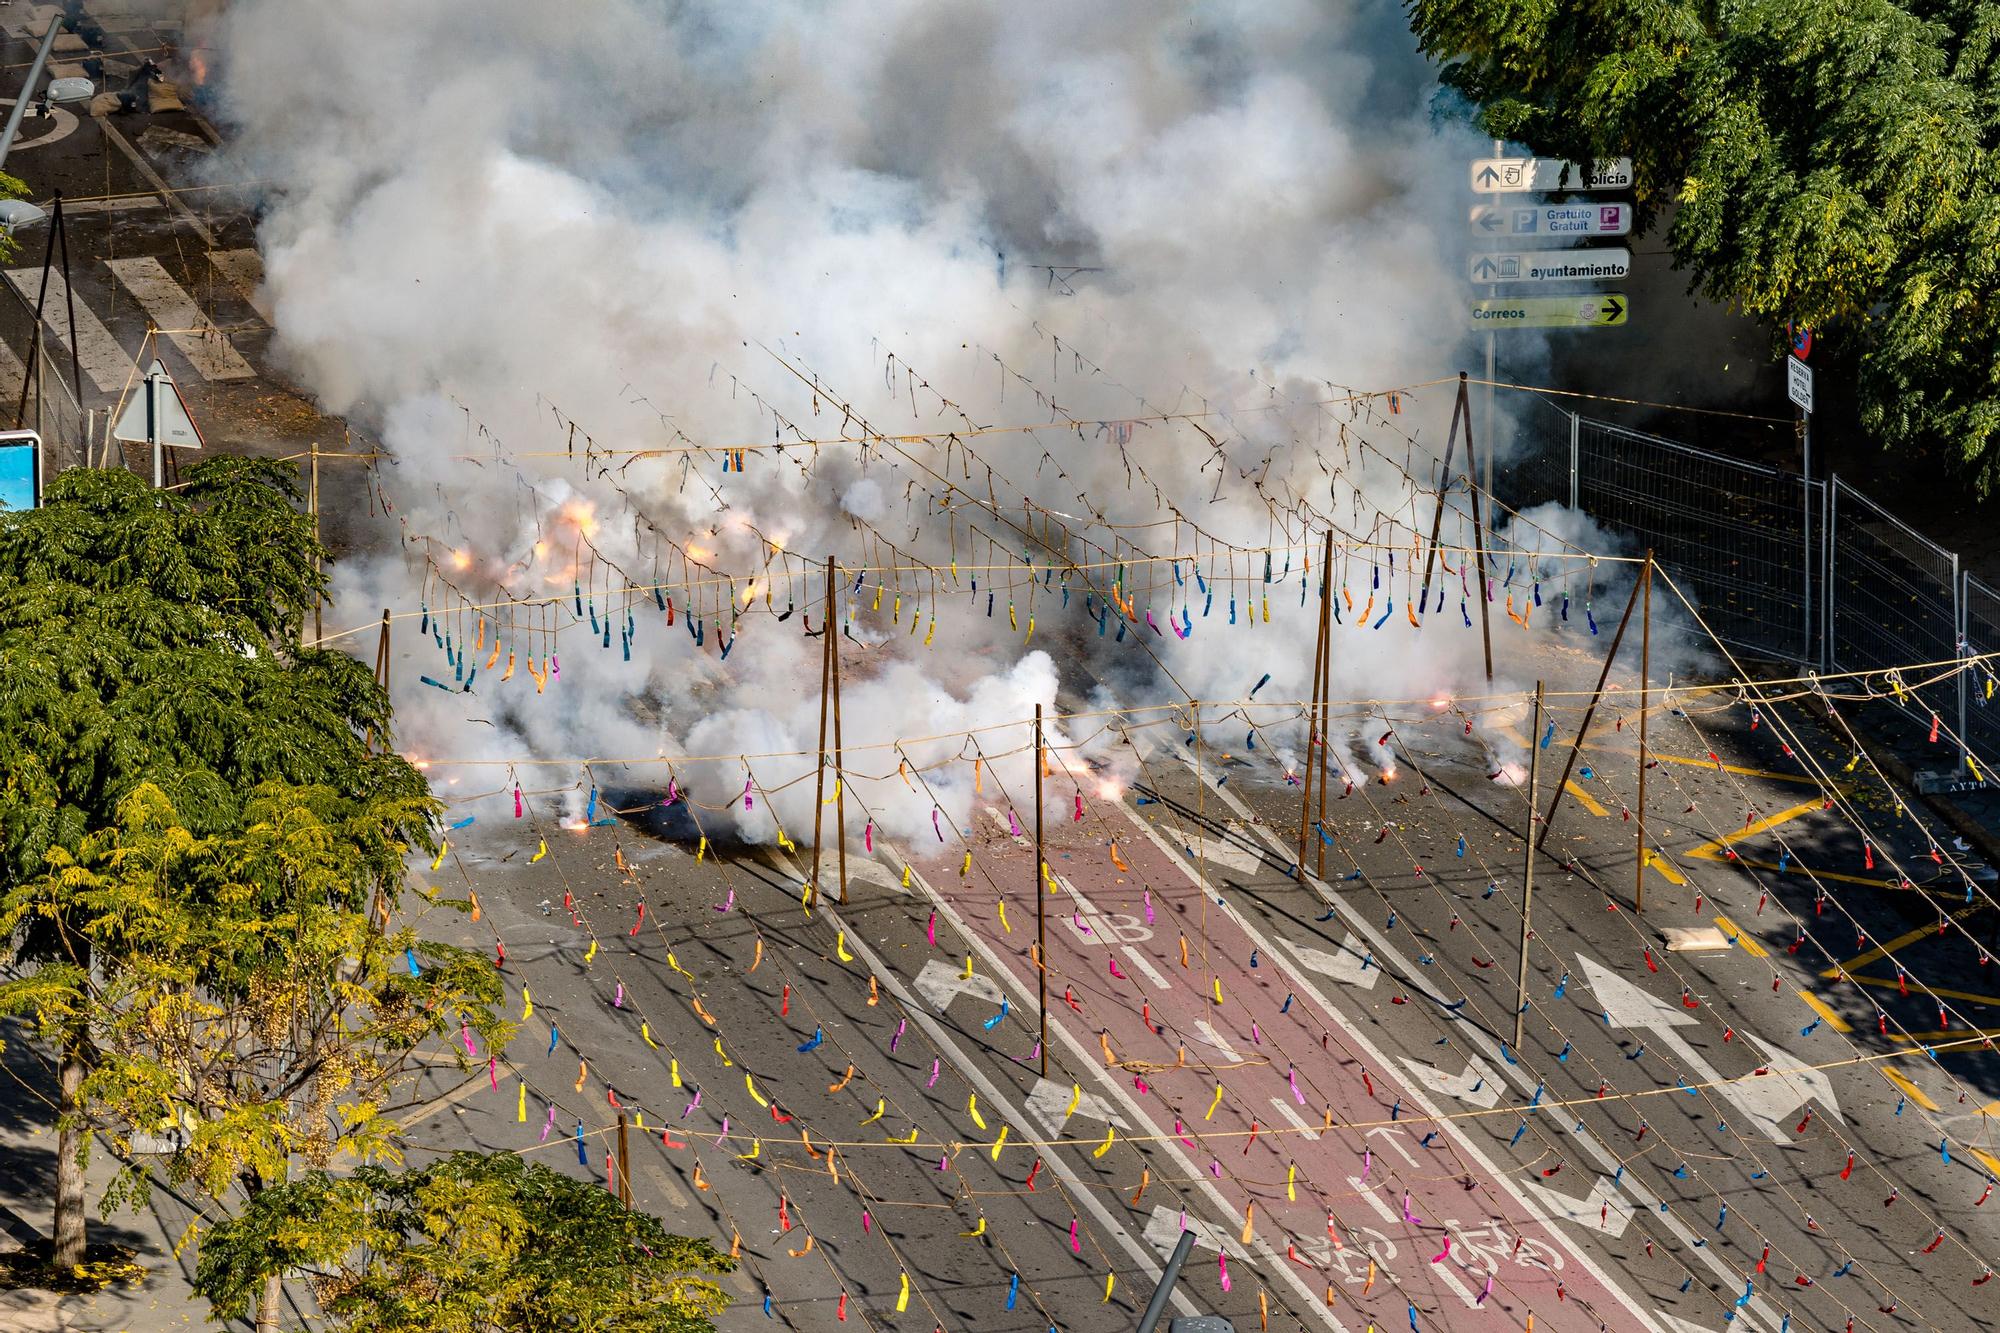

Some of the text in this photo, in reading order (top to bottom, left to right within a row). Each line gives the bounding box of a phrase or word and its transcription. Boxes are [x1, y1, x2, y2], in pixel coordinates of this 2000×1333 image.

[1588, 172, 1628, 185] olicía
[1546, 209, 1592, 220] Gratuito
[1530, 263, 1625, 281] ayuntamiento
[1472, 307, 1526, 320] Correos
[1790, 361, 1810, 383] RESERVA
[1793, 376, 1807, 392] HOTEL
[1791, 386, 1809, 406] GOLDEN
